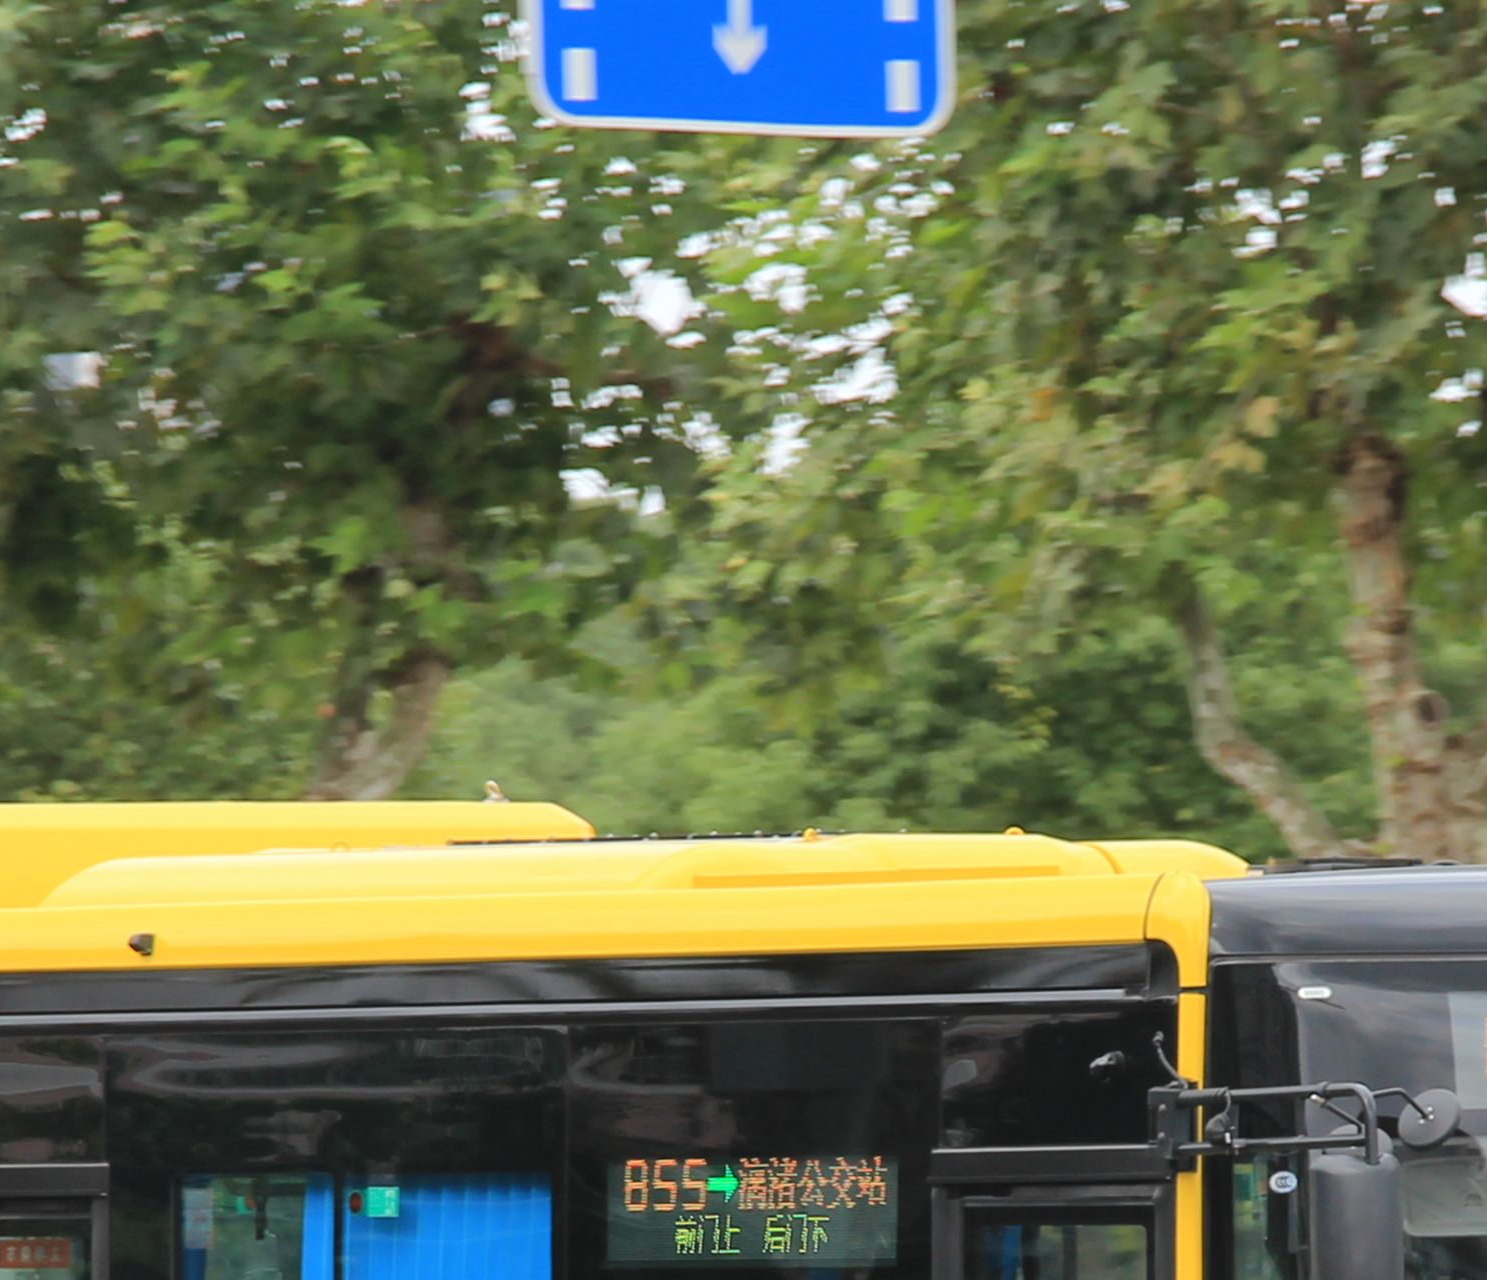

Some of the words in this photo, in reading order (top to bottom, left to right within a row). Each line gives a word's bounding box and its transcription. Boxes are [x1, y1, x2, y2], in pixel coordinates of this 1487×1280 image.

[624, 1158, 708, 1212] 855
[674, 1214, 741, 1254] 前门上
[762, 1213, 830, 1253] 后门下
